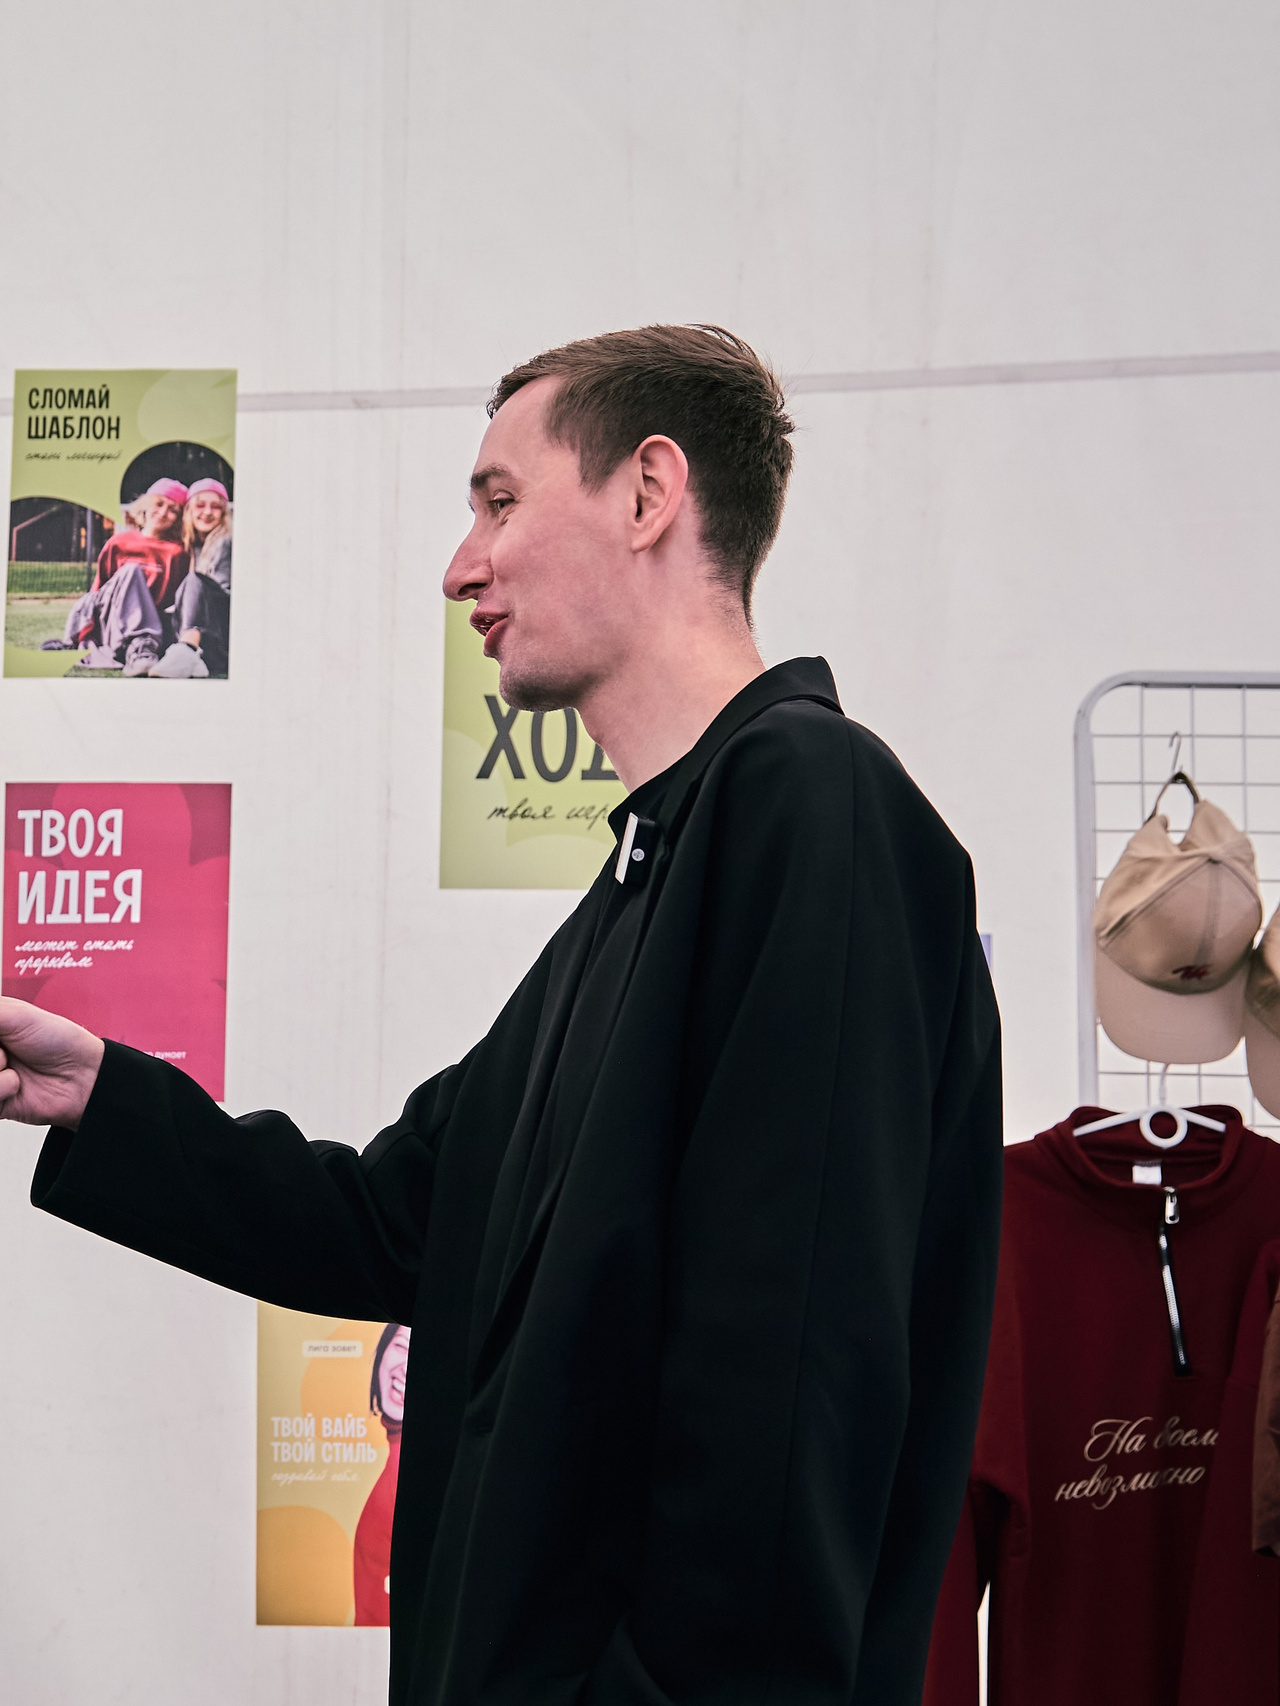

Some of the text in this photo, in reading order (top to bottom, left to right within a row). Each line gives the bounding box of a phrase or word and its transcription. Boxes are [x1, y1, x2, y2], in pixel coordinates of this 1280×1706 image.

[28, 384, 110, 409] СЛОМАЙ
[27, 415, 120, 440] ШАБЛОН
[487, 797, 609, 830] твоя игр
[17, 808, 123, 858] ТВОЯ
[17, 869, 142, 925] ИДЕЯ
[15, 940, 134, 952] может стать
[271, 1413, 367, 1438] ТВОЙ ВАЙБ
[271, 1438, 377, 1463] ТВОЙ СТИЛЬ
[1084, 1416, 1153, 1462] На
